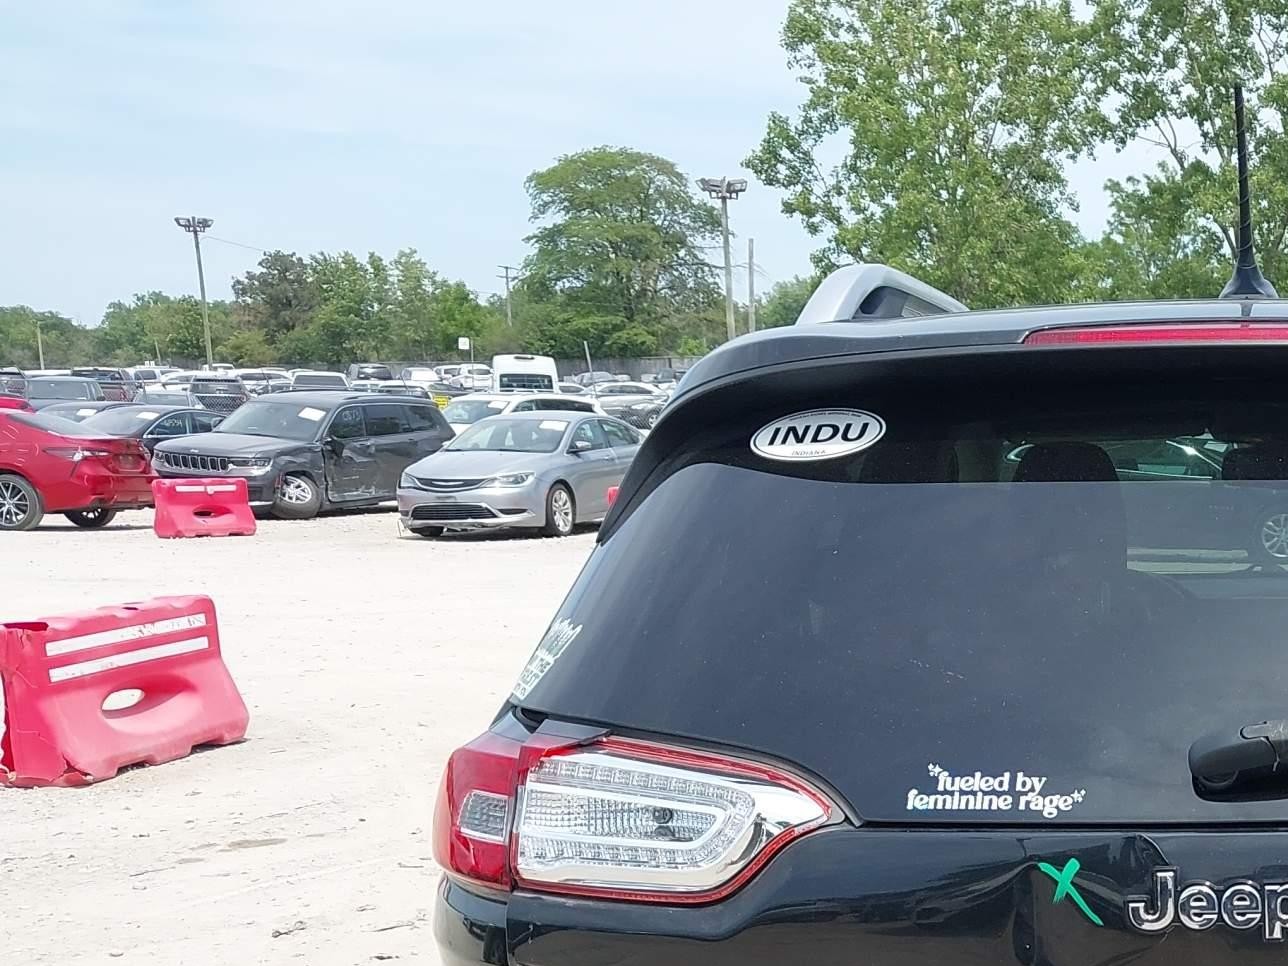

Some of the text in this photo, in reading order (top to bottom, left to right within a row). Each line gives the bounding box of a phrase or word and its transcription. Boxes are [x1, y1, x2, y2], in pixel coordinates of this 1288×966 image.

[768, 422, 870, 447] INDU
[937, 770, 1048, 796] fueled by
[906, 788, 1074, 818] feminine rage
